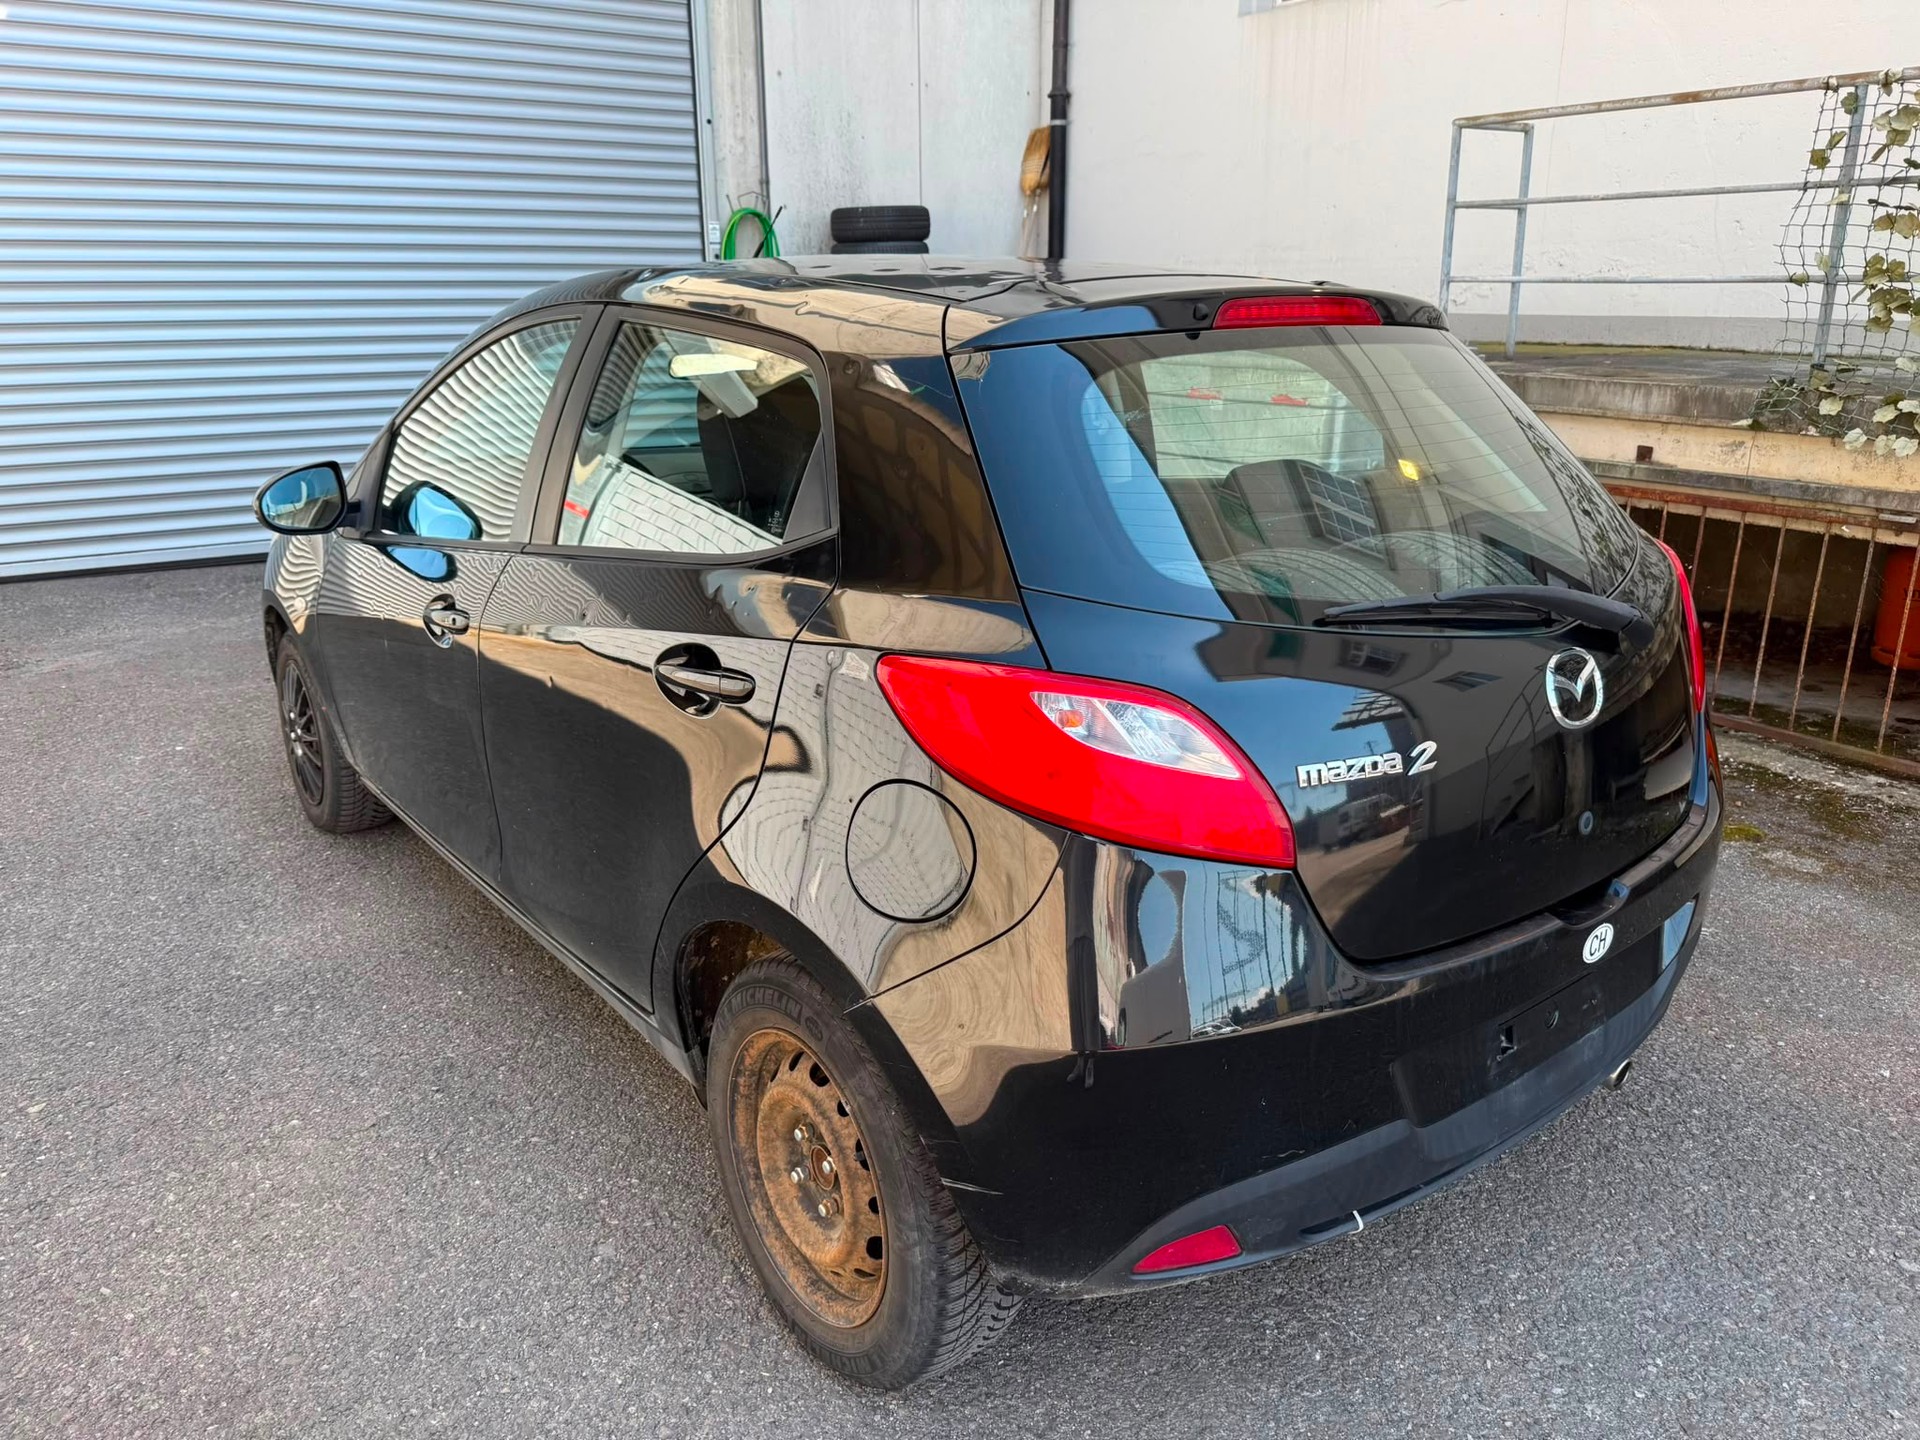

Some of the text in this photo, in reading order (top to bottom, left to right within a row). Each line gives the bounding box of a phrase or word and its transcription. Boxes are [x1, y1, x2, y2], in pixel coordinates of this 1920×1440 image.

[1297, 740, 1438, 788] mazda 2
[1589, 928, 1608, 957] CH
[730, 986, 803, 1023] MICHELIN
